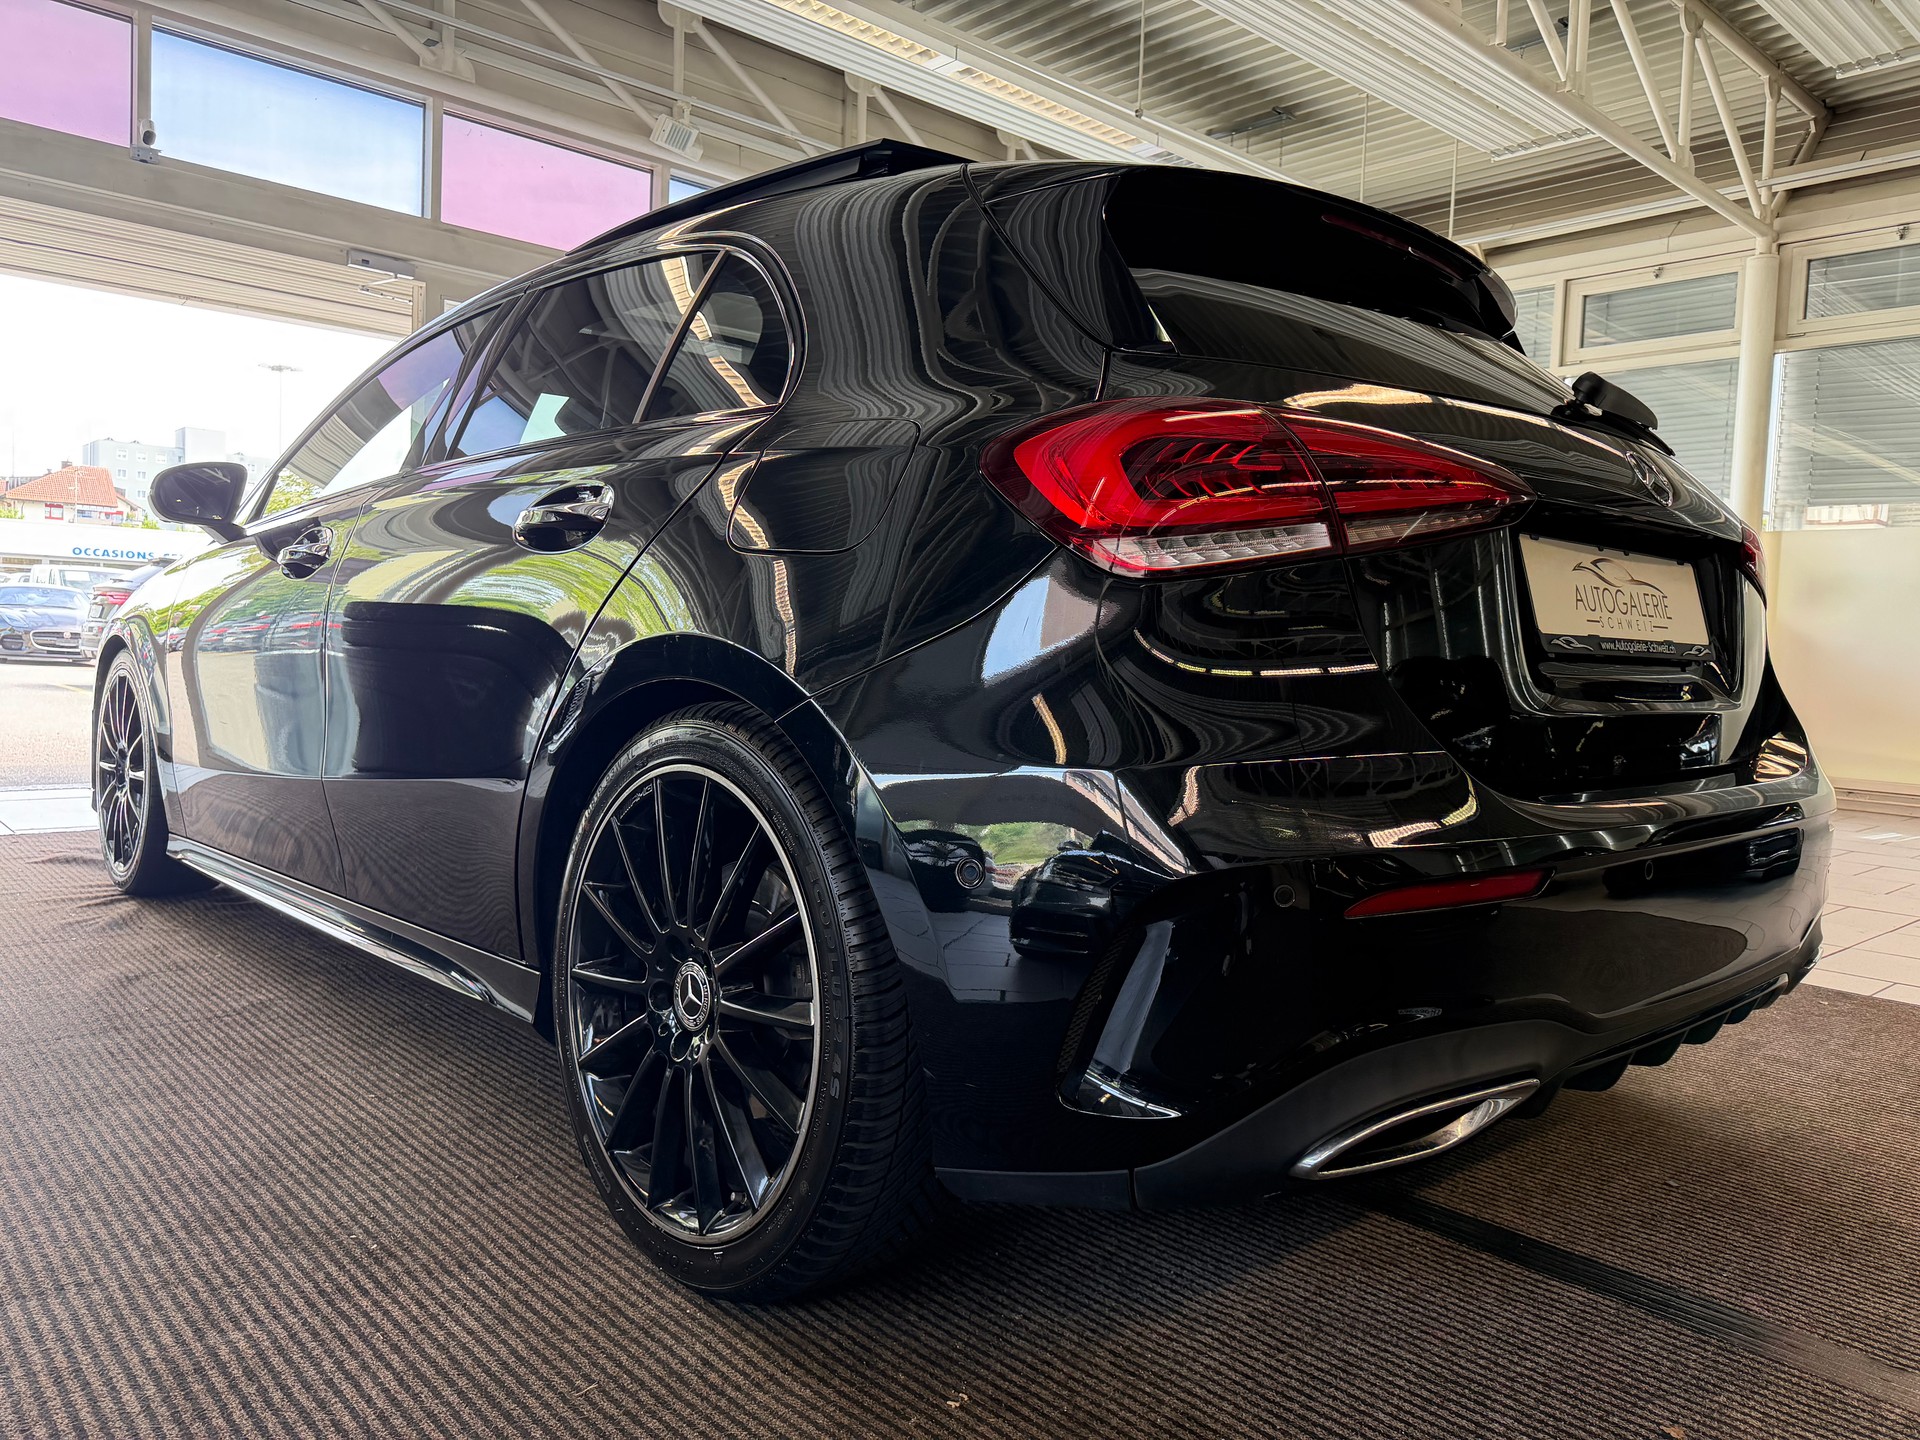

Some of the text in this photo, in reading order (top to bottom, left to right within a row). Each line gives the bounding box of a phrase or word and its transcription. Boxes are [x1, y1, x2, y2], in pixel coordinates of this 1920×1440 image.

[72, 547, 154, 560] OCCASIONS
[1575, 584, 1672, 620] AUTOGALERIE
[1599, 615, 1654, 633] SCHWEIZ
